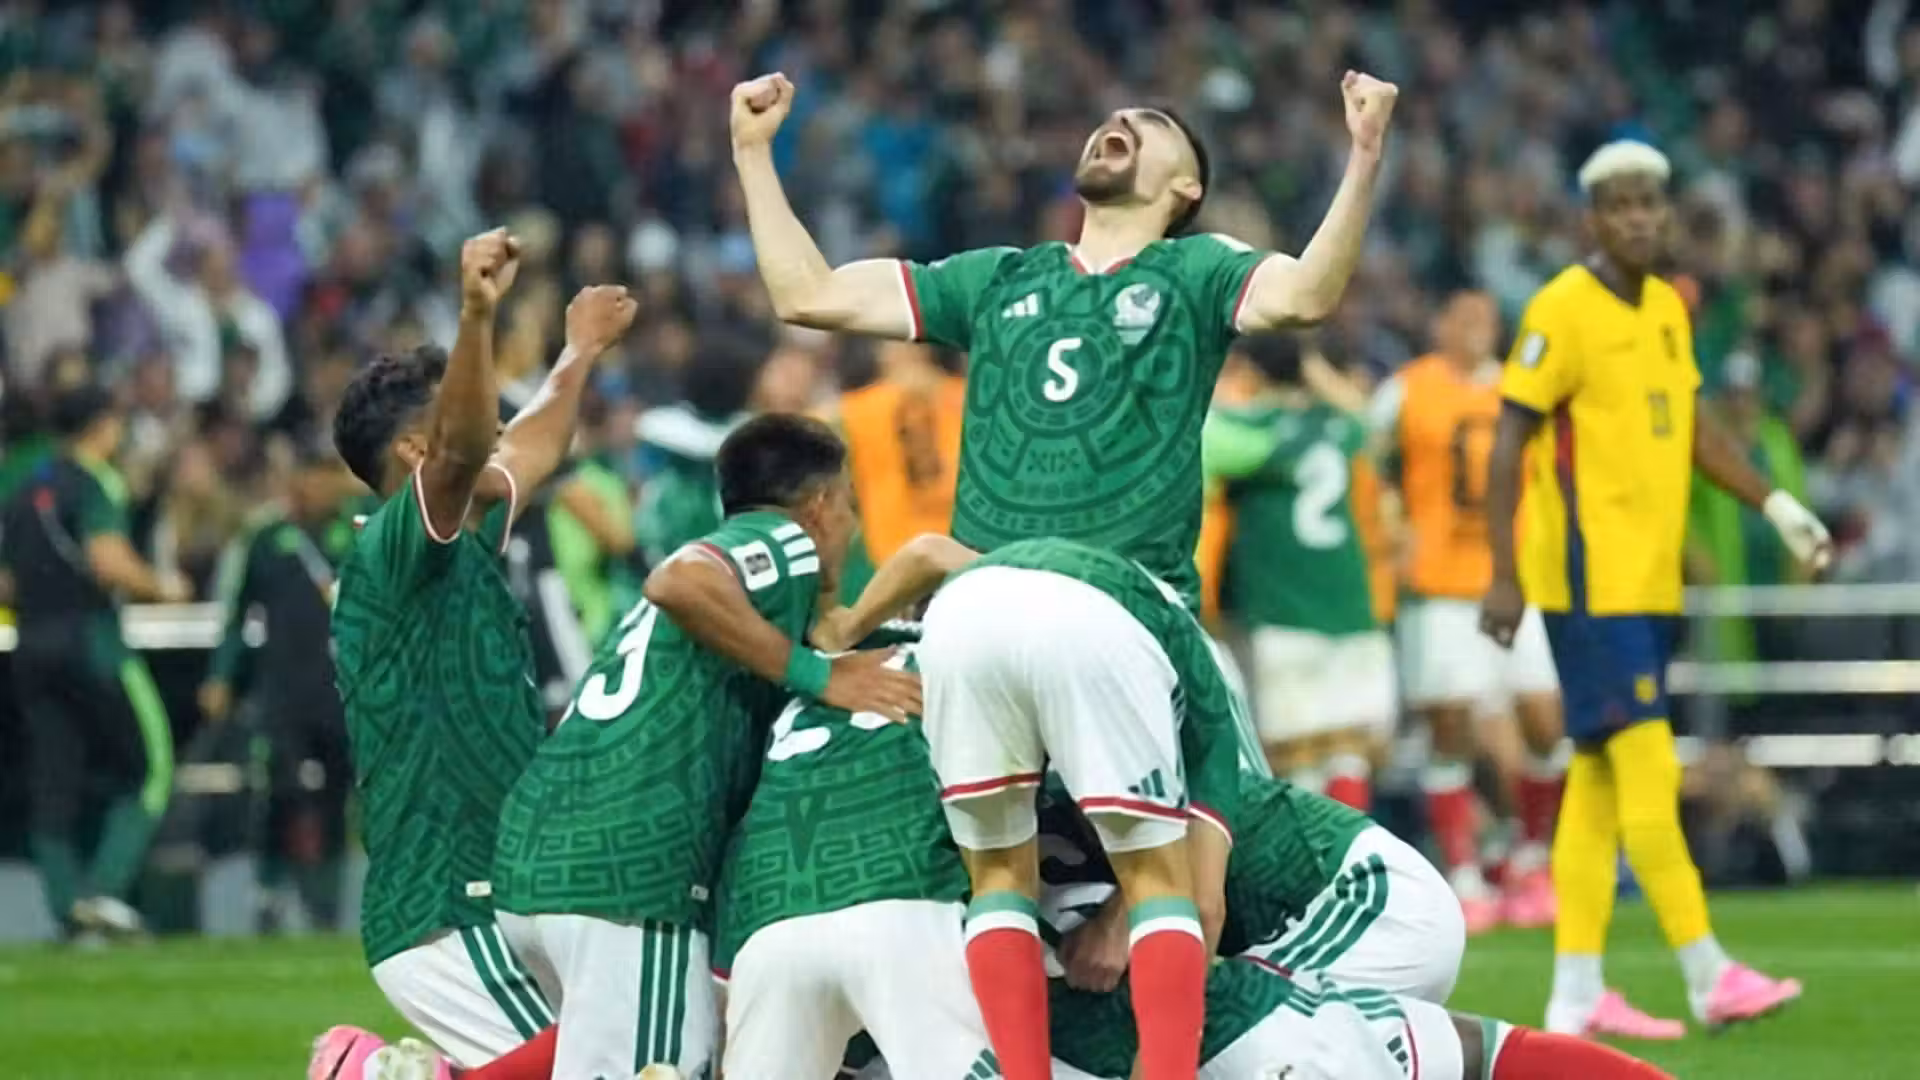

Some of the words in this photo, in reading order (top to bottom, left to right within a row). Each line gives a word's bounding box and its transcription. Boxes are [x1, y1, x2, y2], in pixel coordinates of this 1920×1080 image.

[1041, 336, 1083, 403] 5
[1294, 442, 1348, 549] 2
[562, 597, 659, 722] 3
